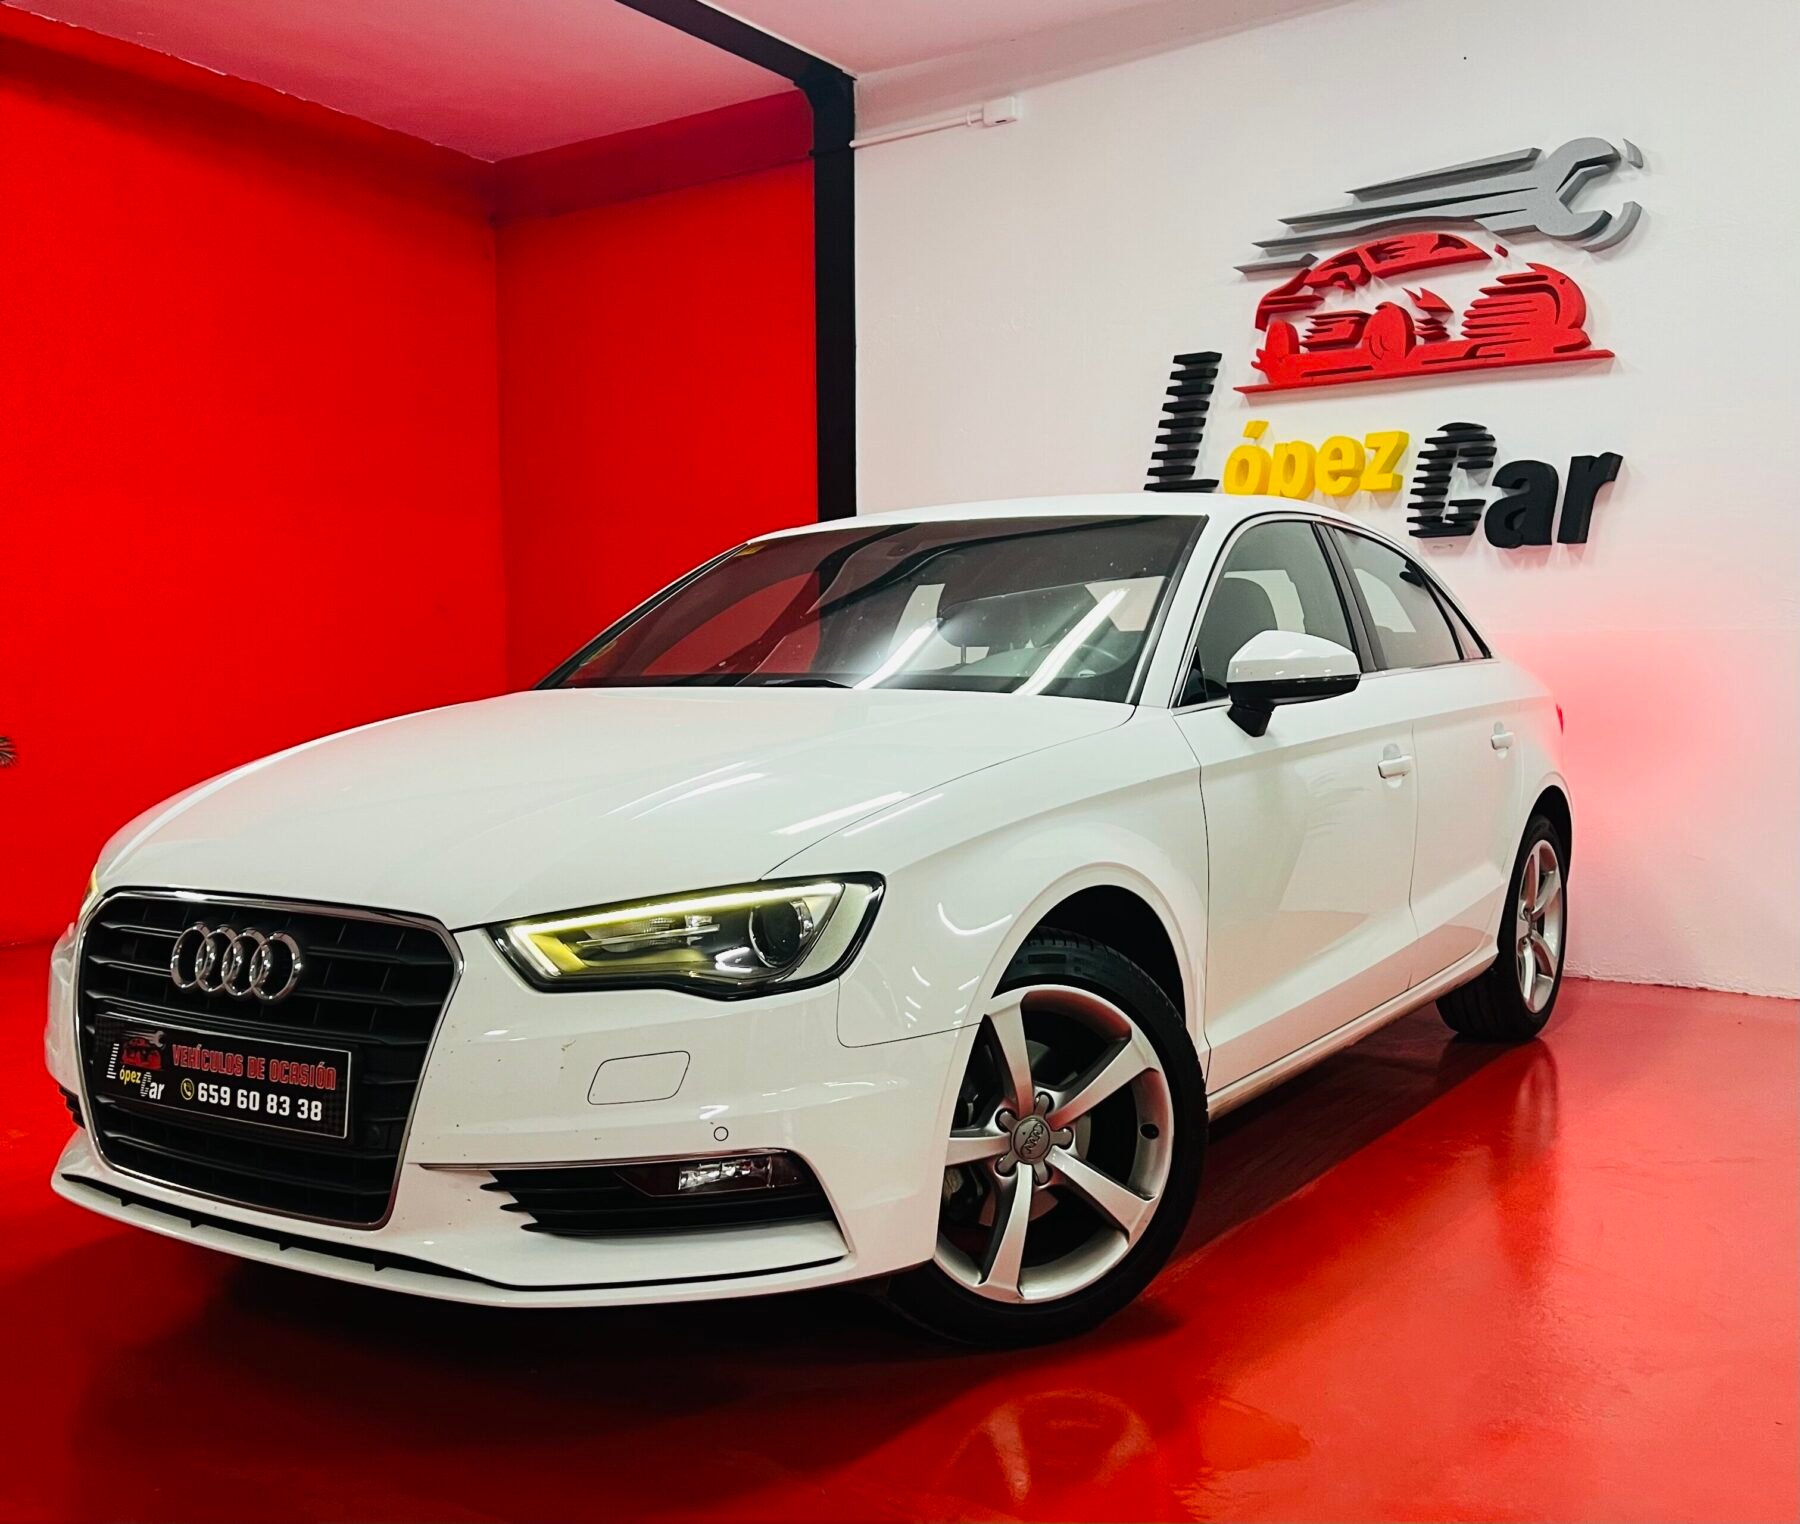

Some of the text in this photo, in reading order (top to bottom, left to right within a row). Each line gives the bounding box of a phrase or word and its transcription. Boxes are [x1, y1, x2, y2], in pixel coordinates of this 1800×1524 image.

[1144, 351, 1623, 549] López Car
[106, 1043, 165, 1100] López Car
[172, 1044, 337, 1091] VEHÍCULOS DE OCASIÓN
[197, 1082, 323, 1122] 659 60 83 38
